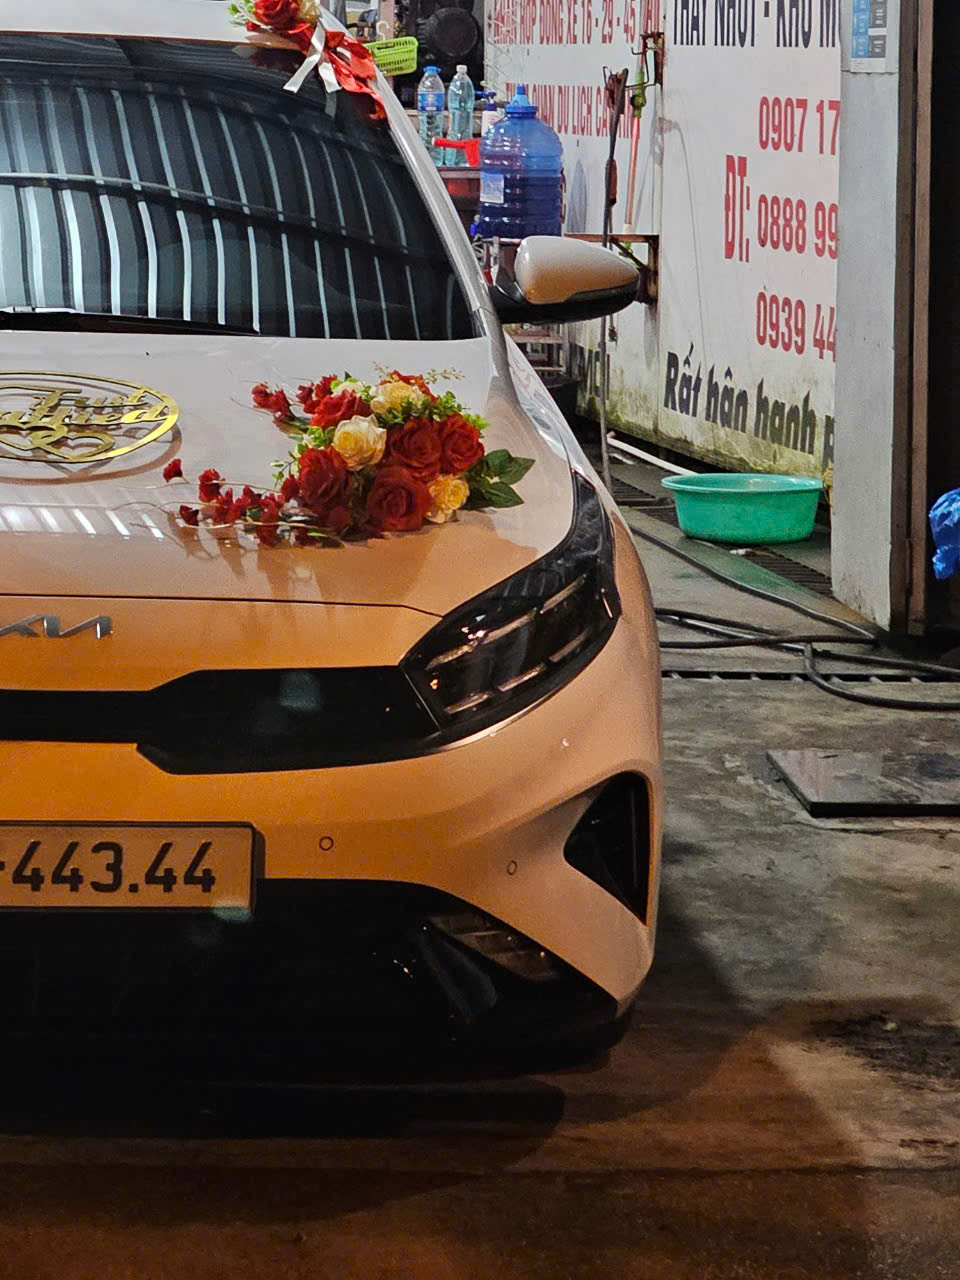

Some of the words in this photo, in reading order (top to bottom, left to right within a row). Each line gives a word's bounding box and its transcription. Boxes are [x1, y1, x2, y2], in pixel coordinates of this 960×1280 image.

[558, 85, 570, 135] DU
[572, 84, 593, 147] LỊCH
[758, 96, 808, 153] 0907
[816, 99, 841, 156] 17
[724, 154, 750, 263] ĐT:
[757, 194, 806, 254] 0888
[814, 201, 838, 260] 99
[756, 291, 806, 355] 0939
[813, 304, 836, 362] 44
[663, 341, 703, 418] Rất
[705, 362, 749, 434] hân
